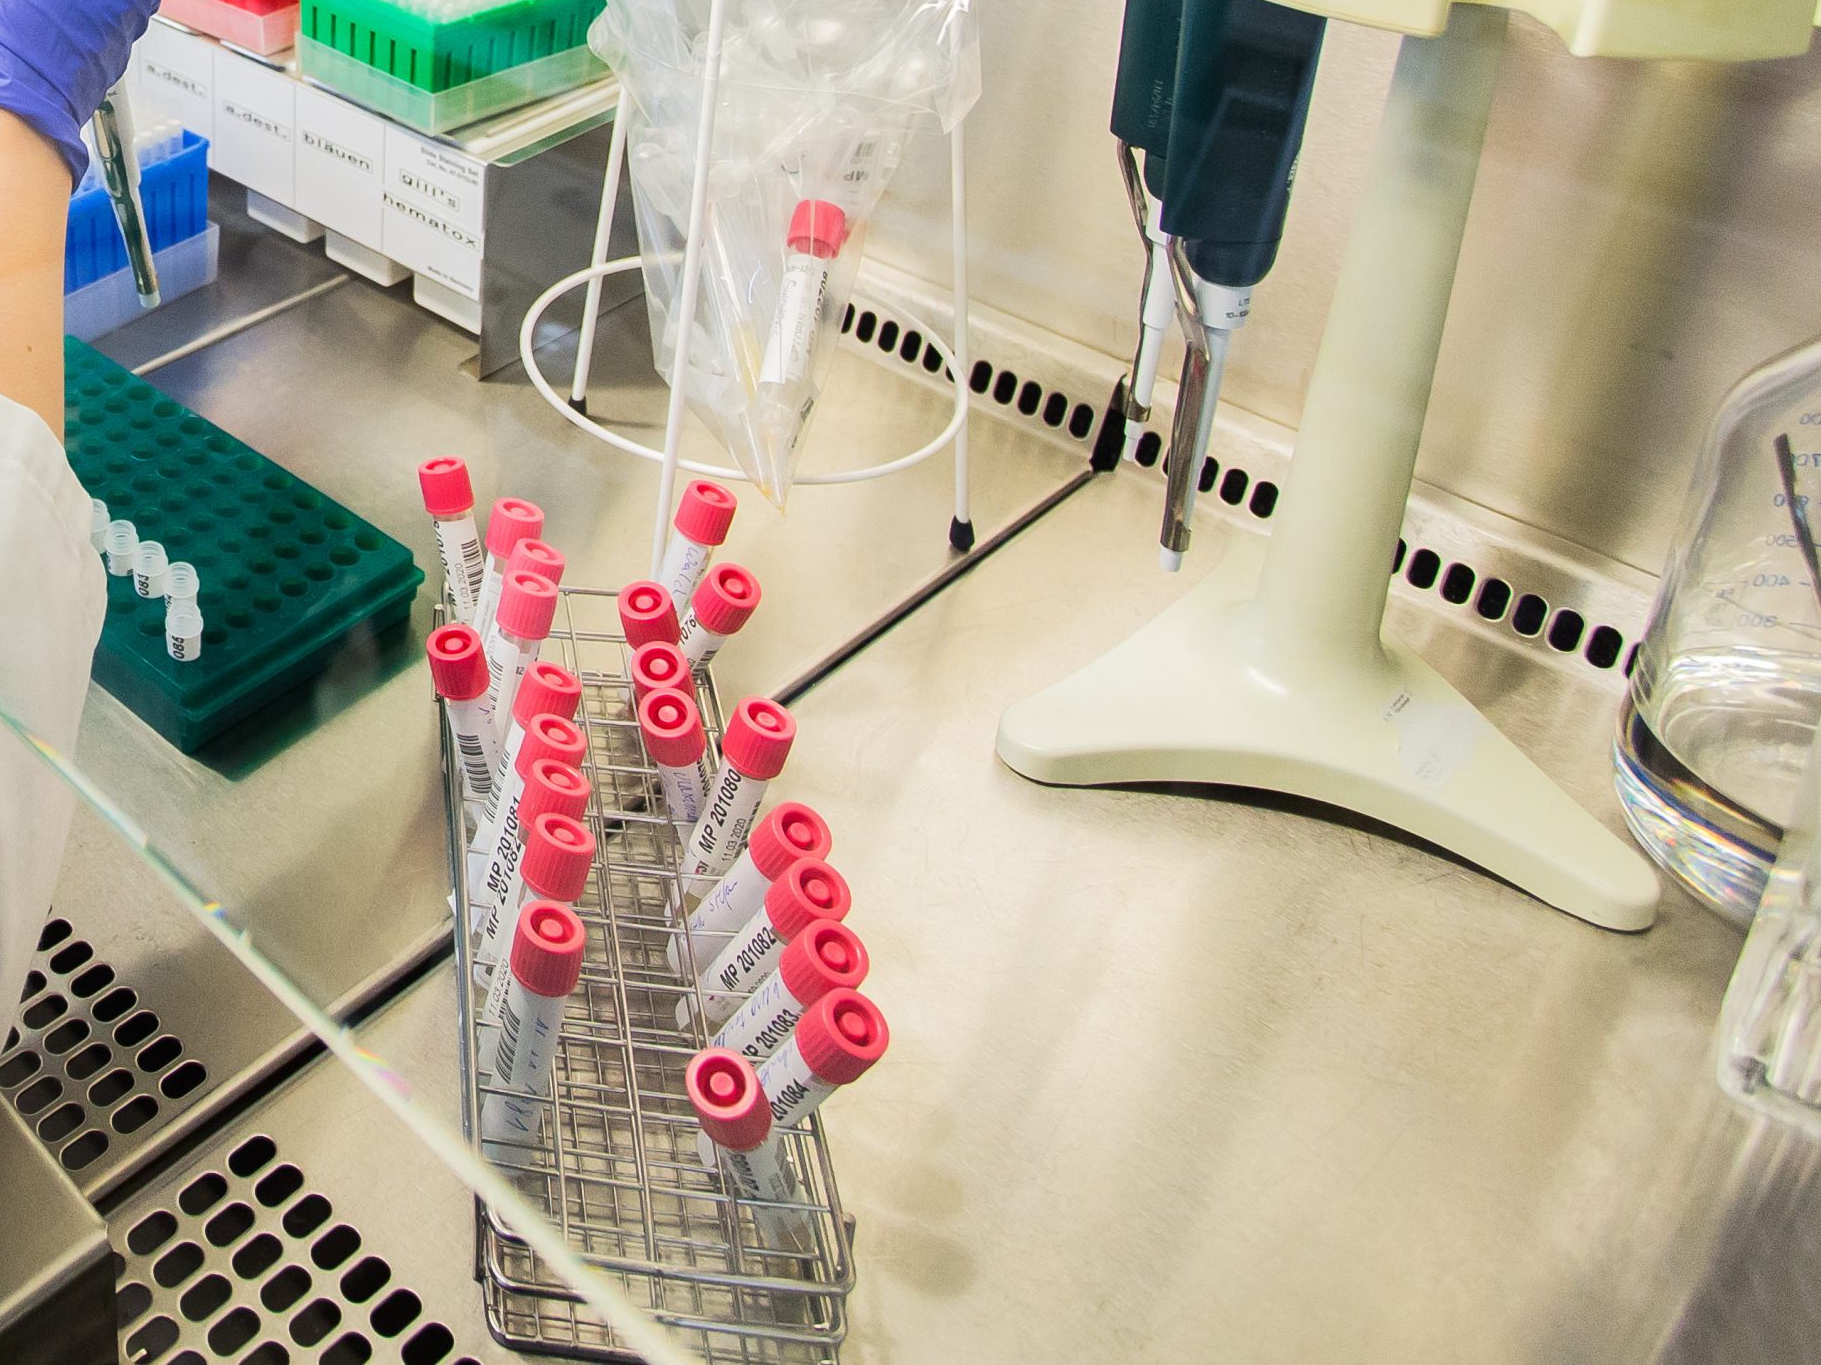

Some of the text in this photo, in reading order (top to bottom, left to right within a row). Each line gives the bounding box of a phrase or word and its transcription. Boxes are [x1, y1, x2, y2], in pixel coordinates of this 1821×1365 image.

[225, 104, 288, 139] a.dest.
[401, 173, 458, 210] gill's
[382, 192, 477, 248] hematox
[171, 635, 185, 660] 085
[698, 824, 717, 855] MP
[710, 768, 742, 828] 201080
[487, 861, 502, 892] MP
[486, 905, 500, 940] MP
[720, 963, 740, 991] MP
[736, 926, 778, 974] 201082
